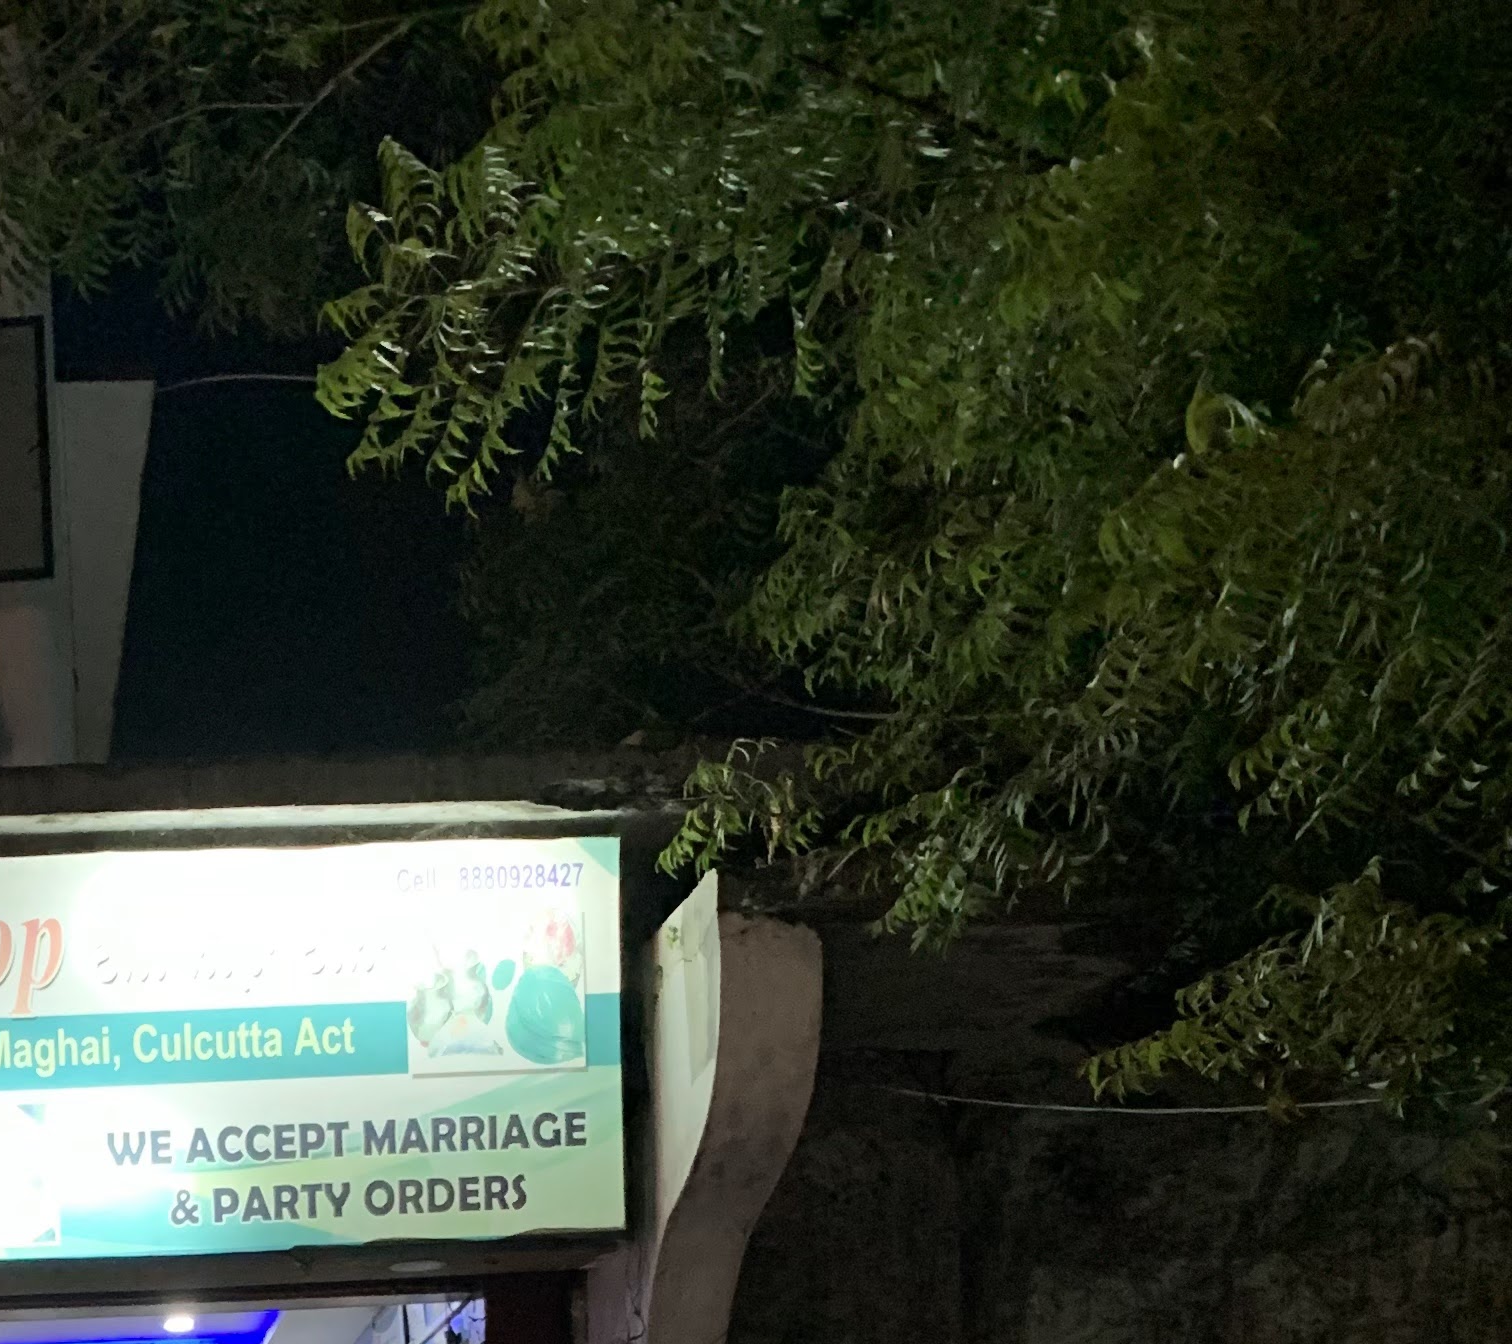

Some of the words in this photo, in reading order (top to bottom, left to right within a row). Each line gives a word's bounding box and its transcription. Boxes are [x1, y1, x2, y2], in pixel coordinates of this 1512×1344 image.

[458, 862, 584, 891] 8880928427
[133, 1019, 284, 1063] Culcutta
[294, 1016, 356, 1057] Act
[106, 1129, 173, 1167] WE
[186, 1121, 351, 1165] ACCEPT
[363, 1111, 588, 1157] MARRIAGE
[169, 1189, 200, 1226] &
[213, 1181, 352, 1224] PARTY
[365, 1173, 529, 1218] ORDERS
